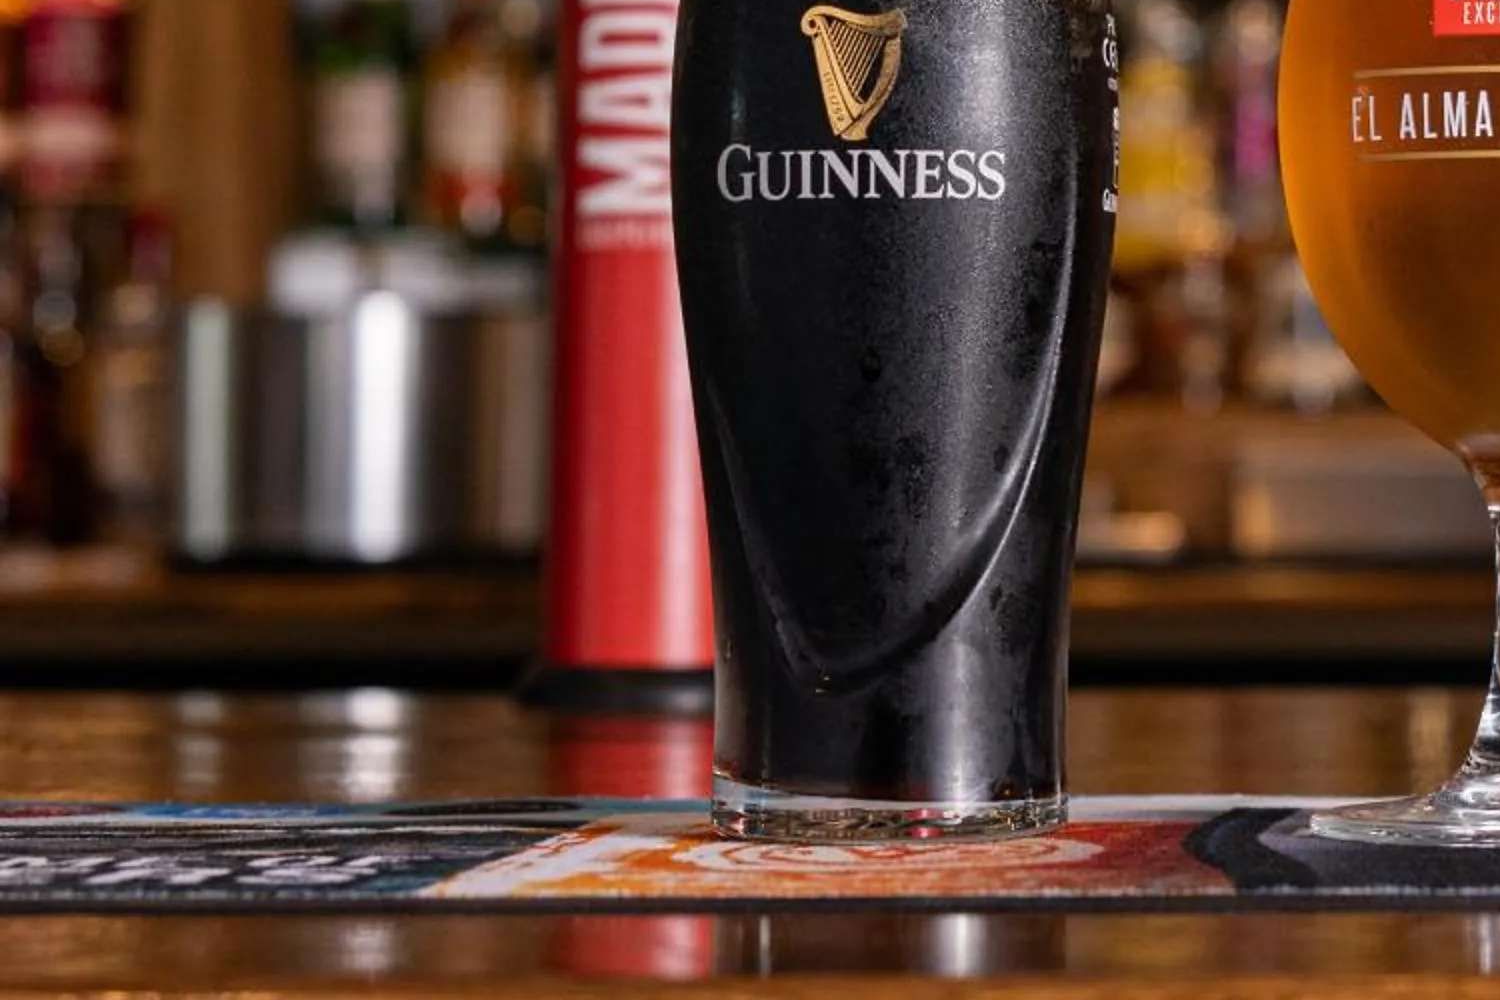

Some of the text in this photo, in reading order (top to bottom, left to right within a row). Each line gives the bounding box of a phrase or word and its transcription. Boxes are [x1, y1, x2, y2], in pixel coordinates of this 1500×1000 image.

[1352, 95, 1382, 142] EL
[1400, 90, 1494, 139] ALMA
[717, 143, 1006, 201] GUINNESS
